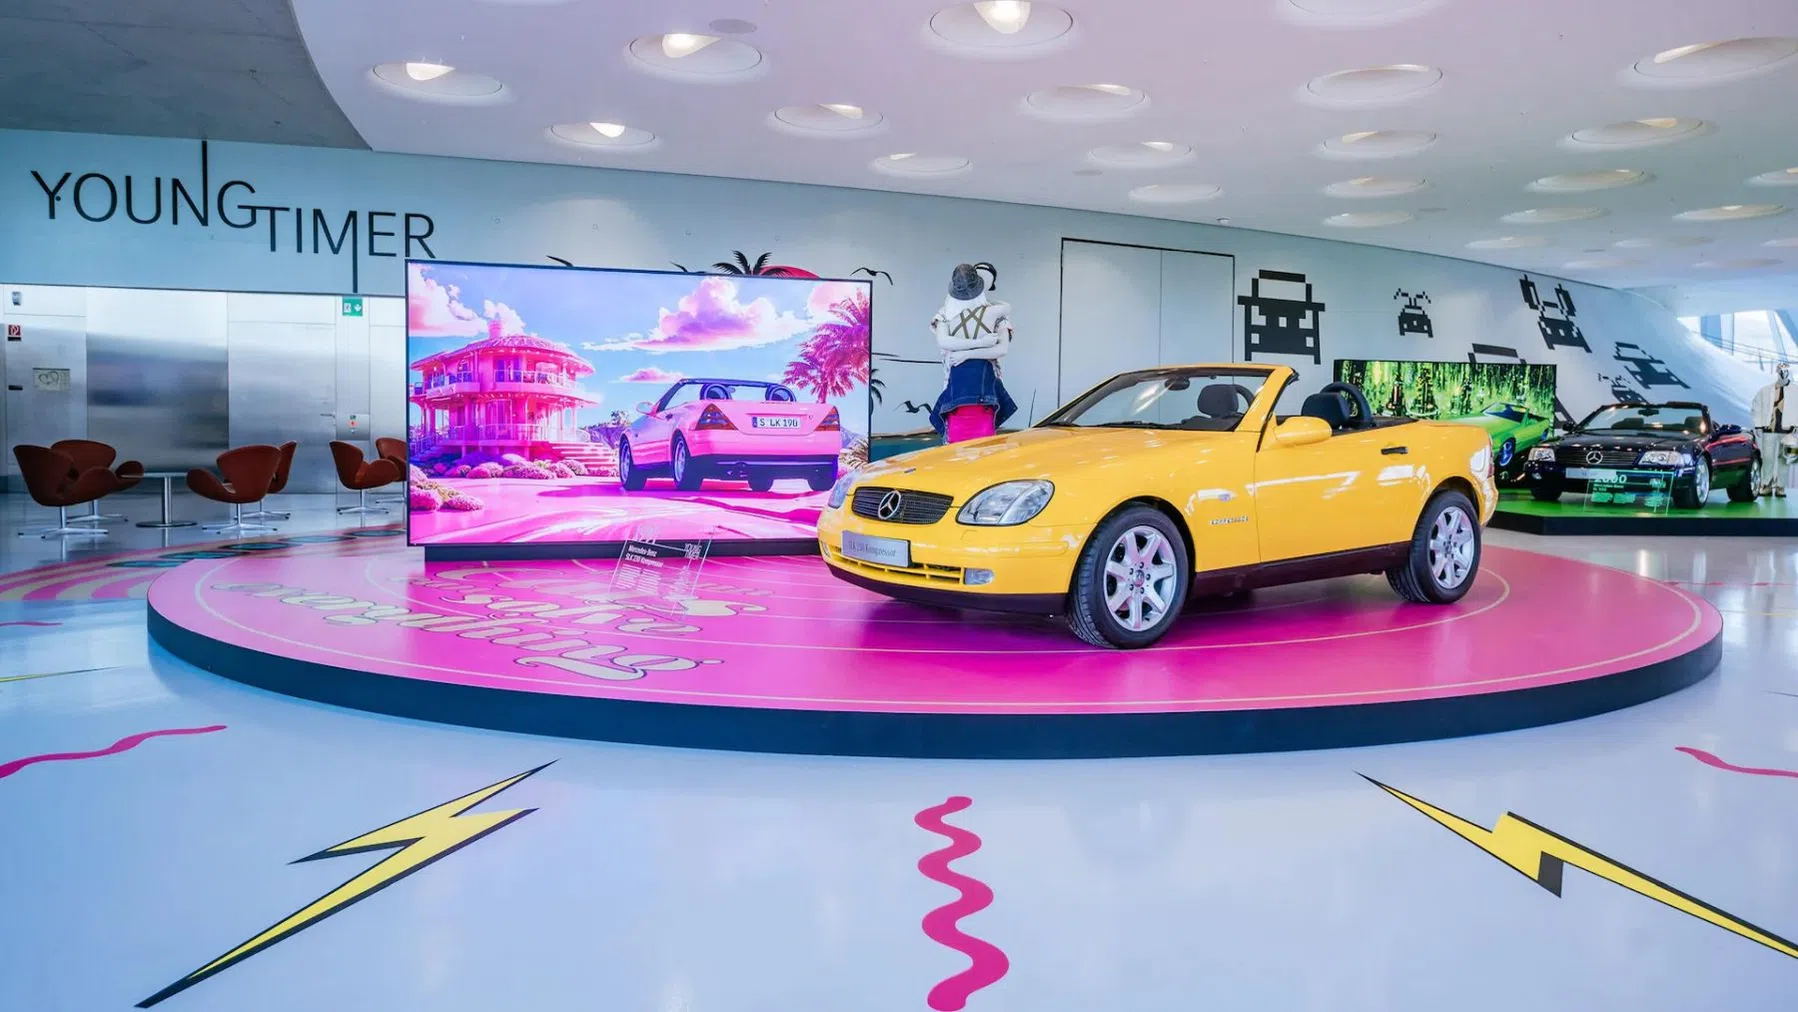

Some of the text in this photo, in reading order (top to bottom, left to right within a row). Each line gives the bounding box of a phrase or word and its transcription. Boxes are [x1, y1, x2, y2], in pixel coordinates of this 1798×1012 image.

[759, 418, 765, 427] S
[209, 582, 724, 682] everything
[439, 595, 702, 635] solve
